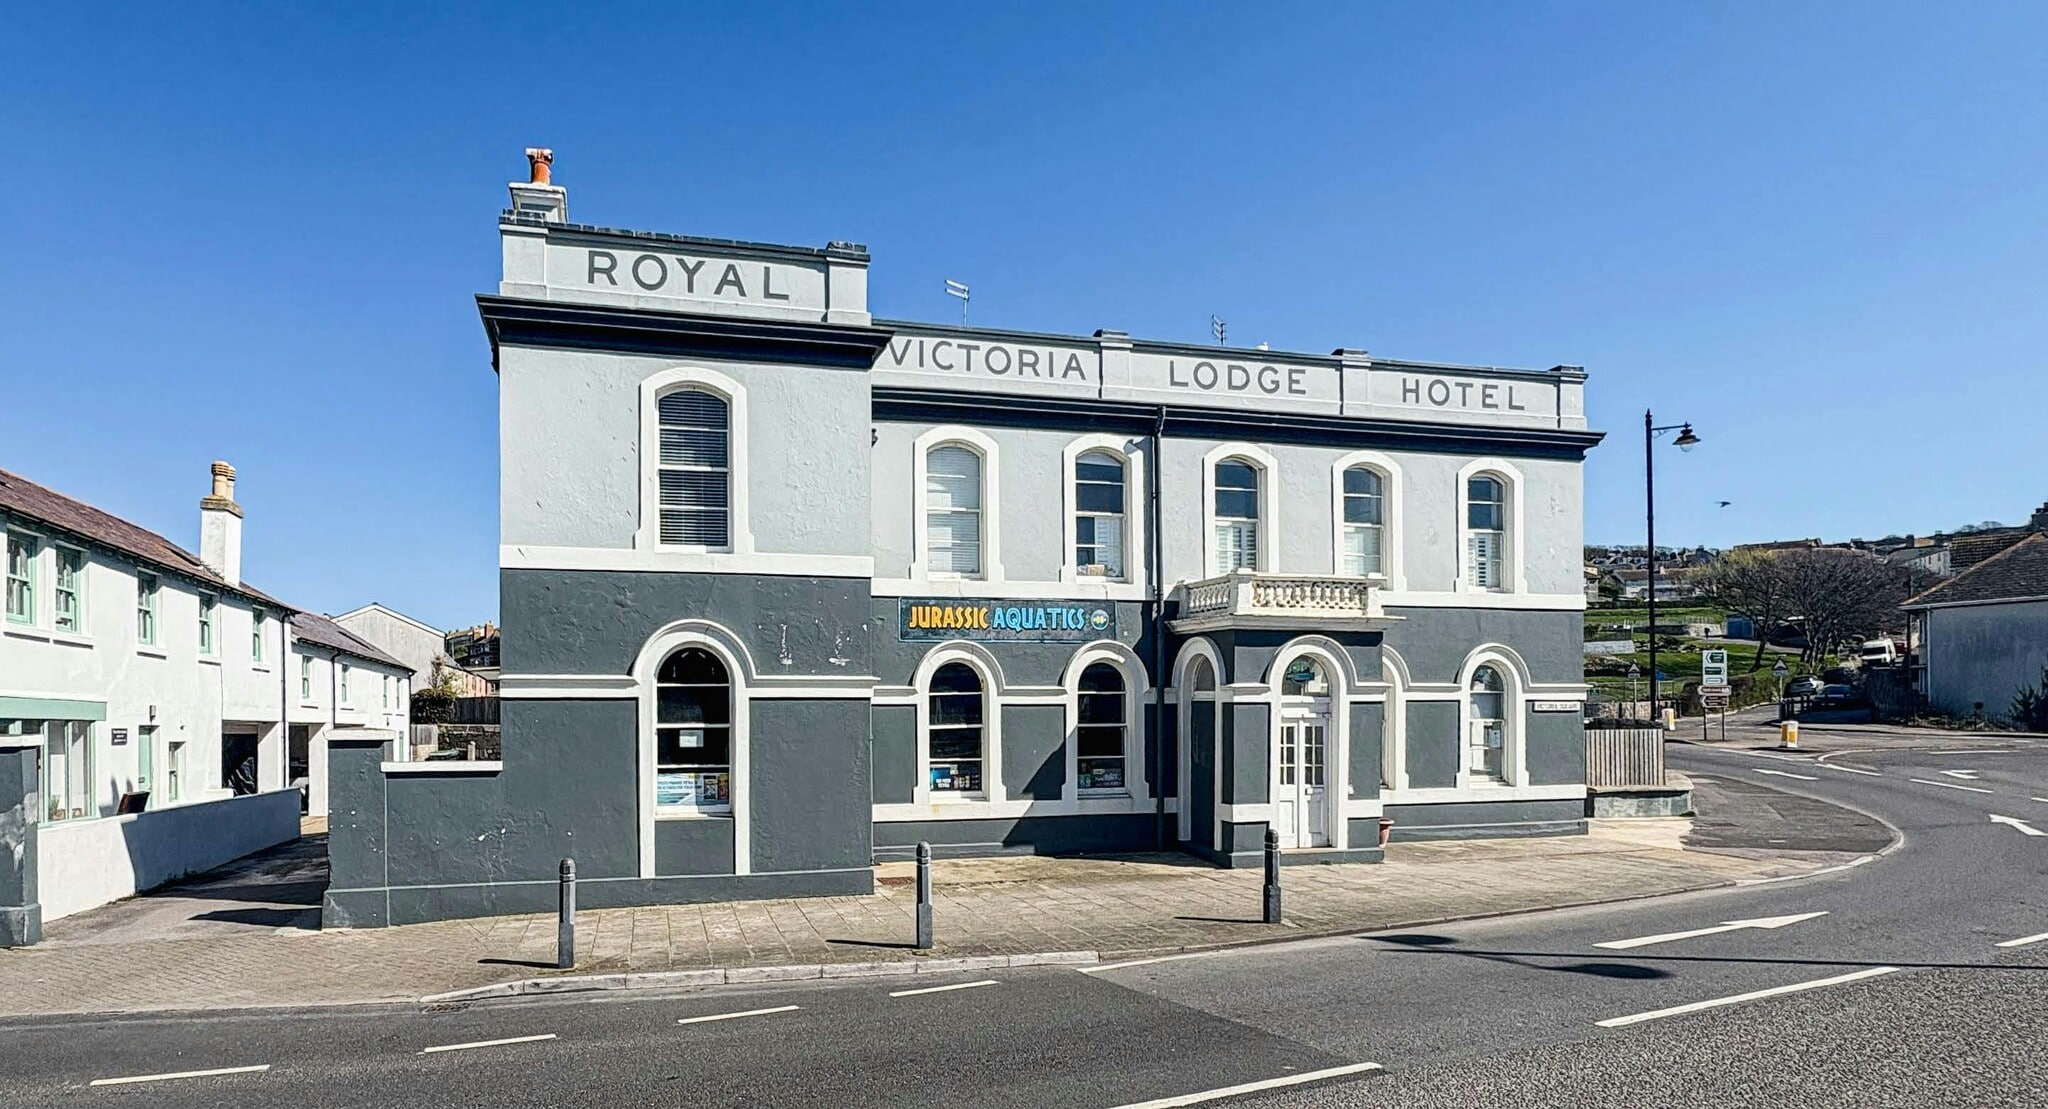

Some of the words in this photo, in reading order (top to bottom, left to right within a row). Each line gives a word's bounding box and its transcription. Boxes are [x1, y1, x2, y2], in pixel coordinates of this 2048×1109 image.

[588, 250, 789, 300] ROYAL
[888, 339, 1086, 380] VICTORIA
[1169, 360, 1306, 395] LODGE
[1402, 377, 1525, 410] HOTEL
[909, 606, 989, 629] JURASSIC
[993, 607, 1085, 632] AQUATICS
